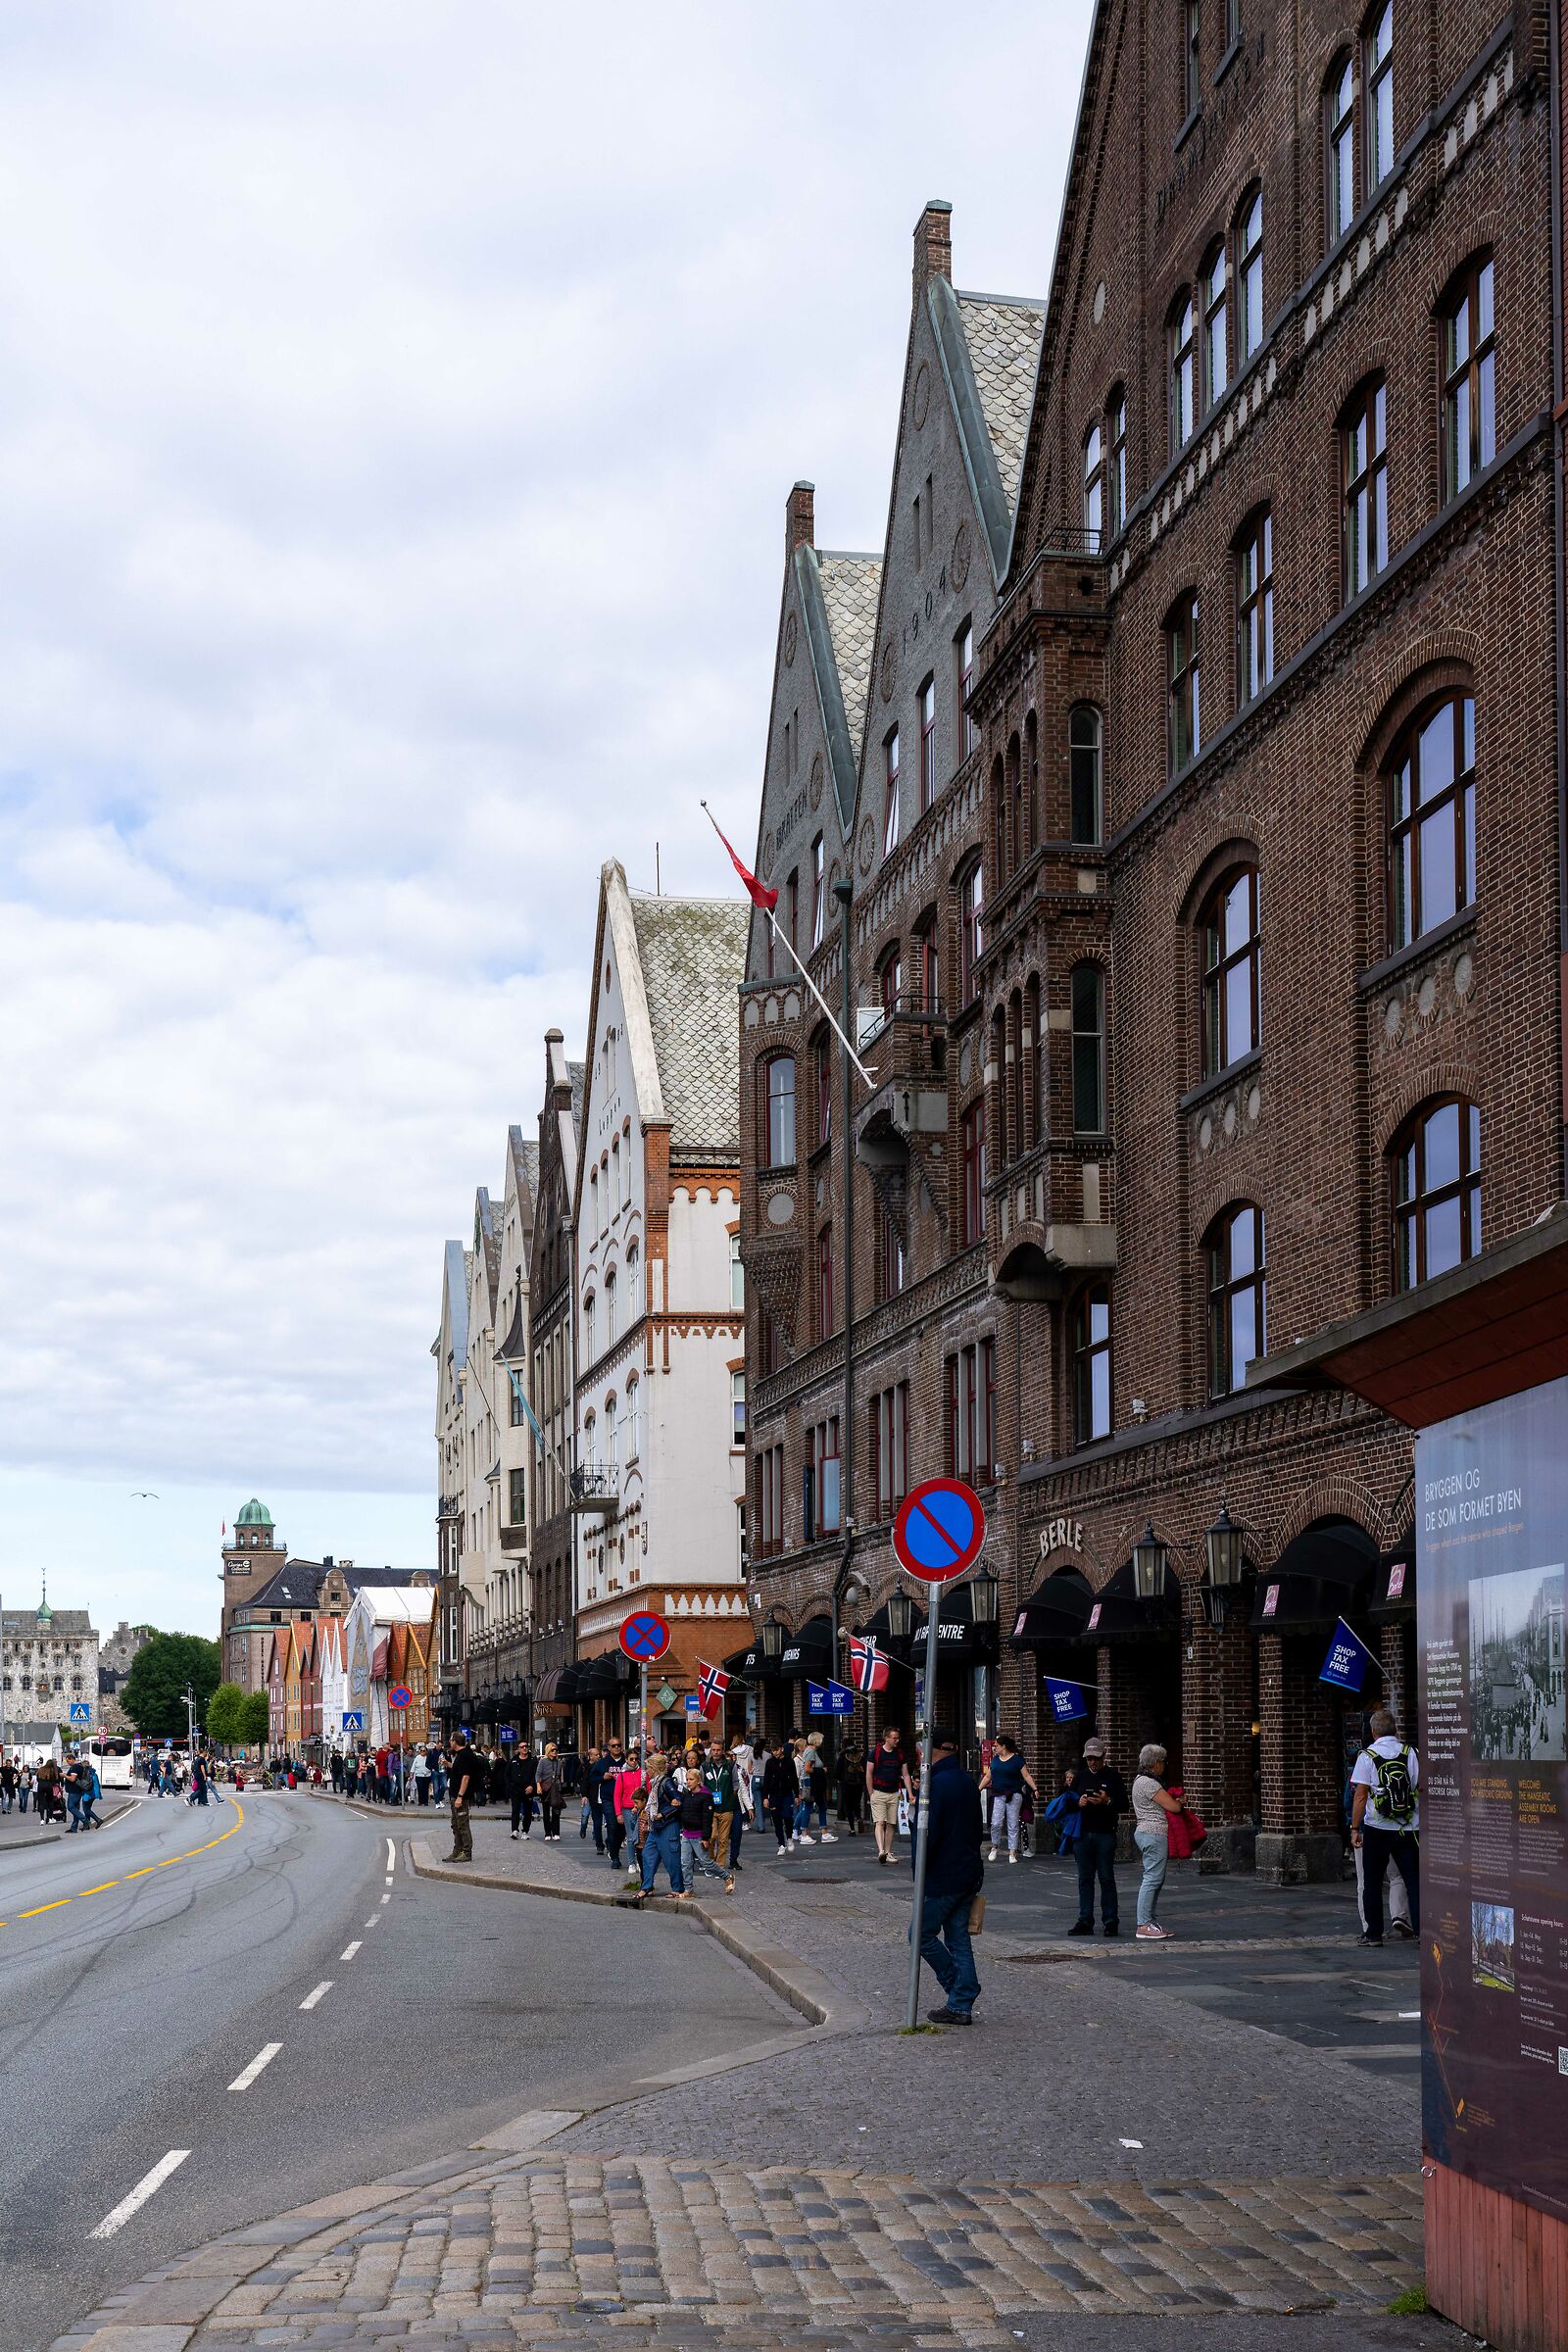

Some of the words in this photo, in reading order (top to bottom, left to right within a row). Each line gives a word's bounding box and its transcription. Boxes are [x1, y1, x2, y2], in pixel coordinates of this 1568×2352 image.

[904, 565, 947, 657] 1904
[1425, 1473, 1462, 1502] BRYGGEN
[1465, 1468, 1480, 1491] OG
[1425, 1511, 1436, 1532] DE
[1438, 1505, 1457, 1529] SOM
[1459, 1494, 1494, 1523] FORMET
[1497, 1488, 1522, 1513] BYEN
[1039, 1517, 1083, 1559] BERLE
[938, 1624, 965, 1640] ENTRE
[1334, 1644, 1357, 1657] SHOP
[1333, 1652, 1348, 1665] TAX
[1329, 1660, 1350, 1675] FREE
[1054, 1690, 1070, 1700] SHOP
[1055, 1697, 1068, 1706] TAX
[1056, 1703, 1073, 1713] FREE
